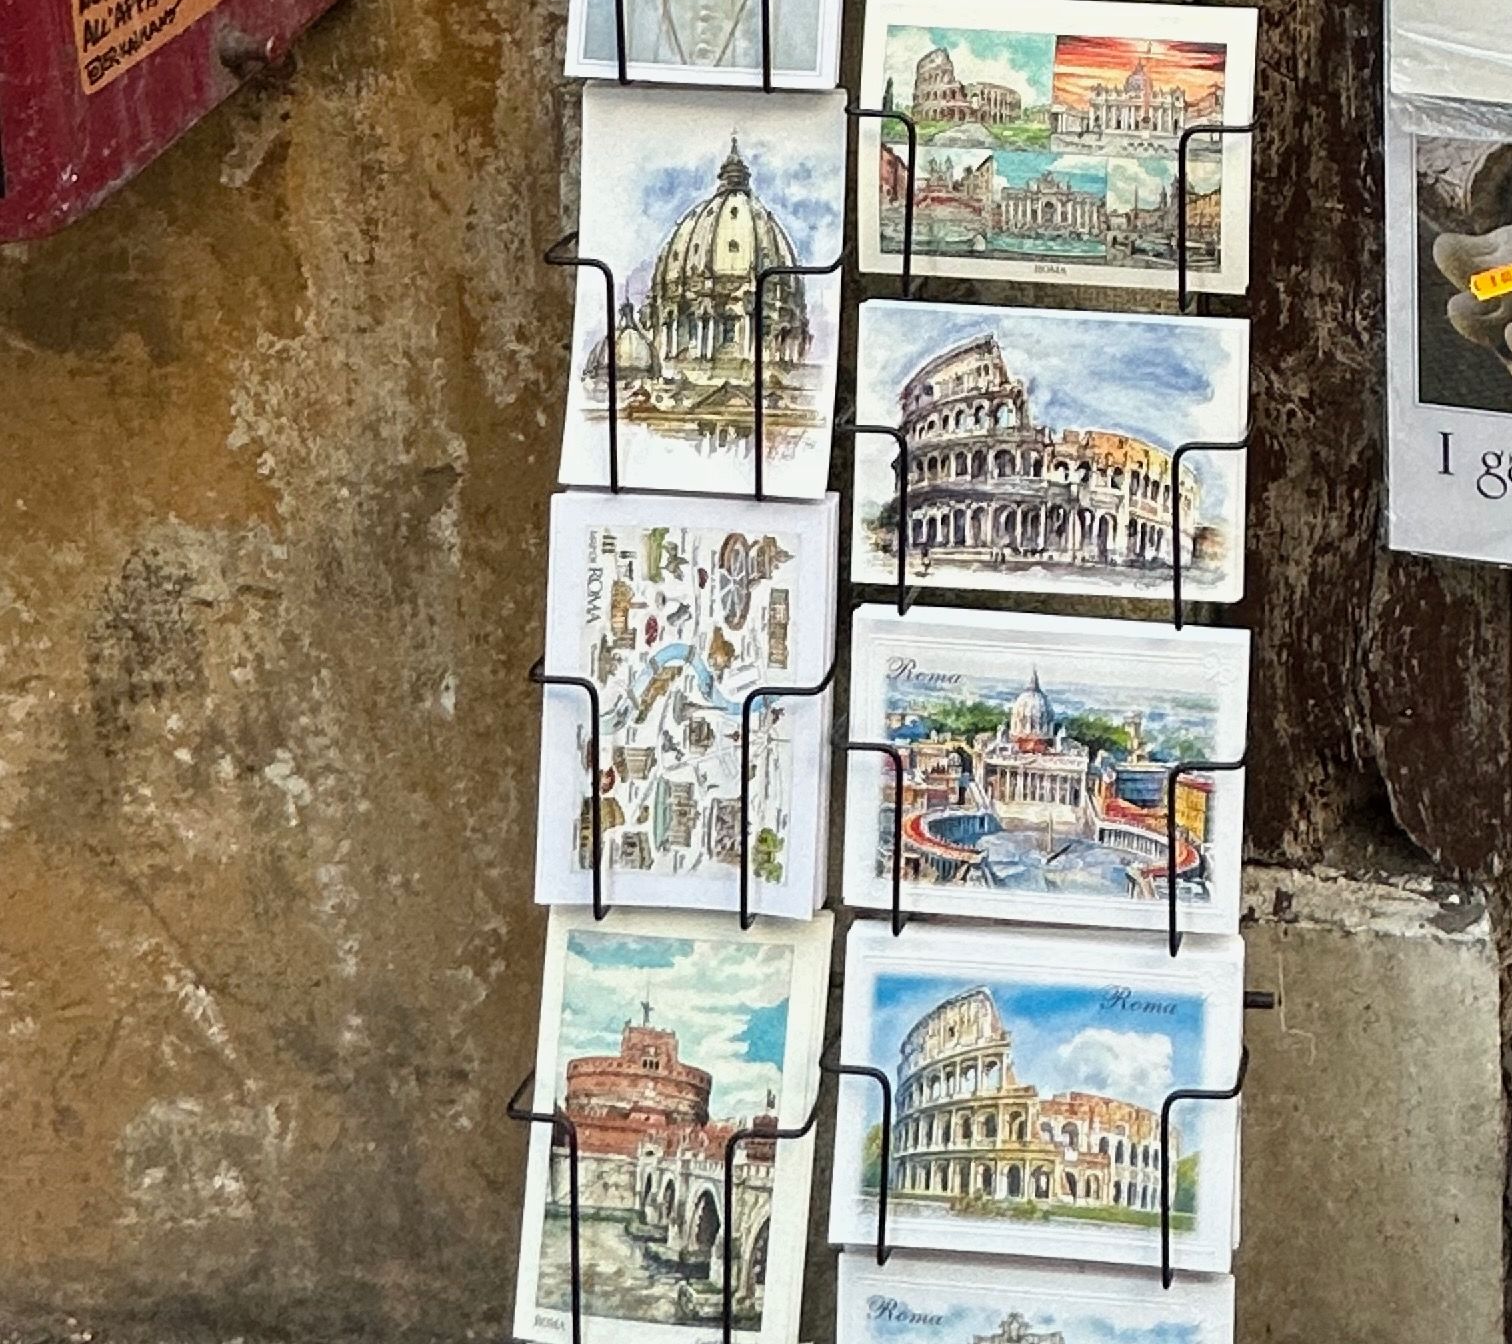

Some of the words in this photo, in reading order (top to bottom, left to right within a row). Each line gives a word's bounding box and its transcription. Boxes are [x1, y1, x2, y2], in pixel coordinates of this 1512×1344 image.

[1437, 431, 1454, 476] I
[586, 566, 604, 625] ROMA
[885, 656, 964, 685] Roma
[1099, 983, 1178, 1016] Roma
[867, 1293, 945, 1327] Roma
